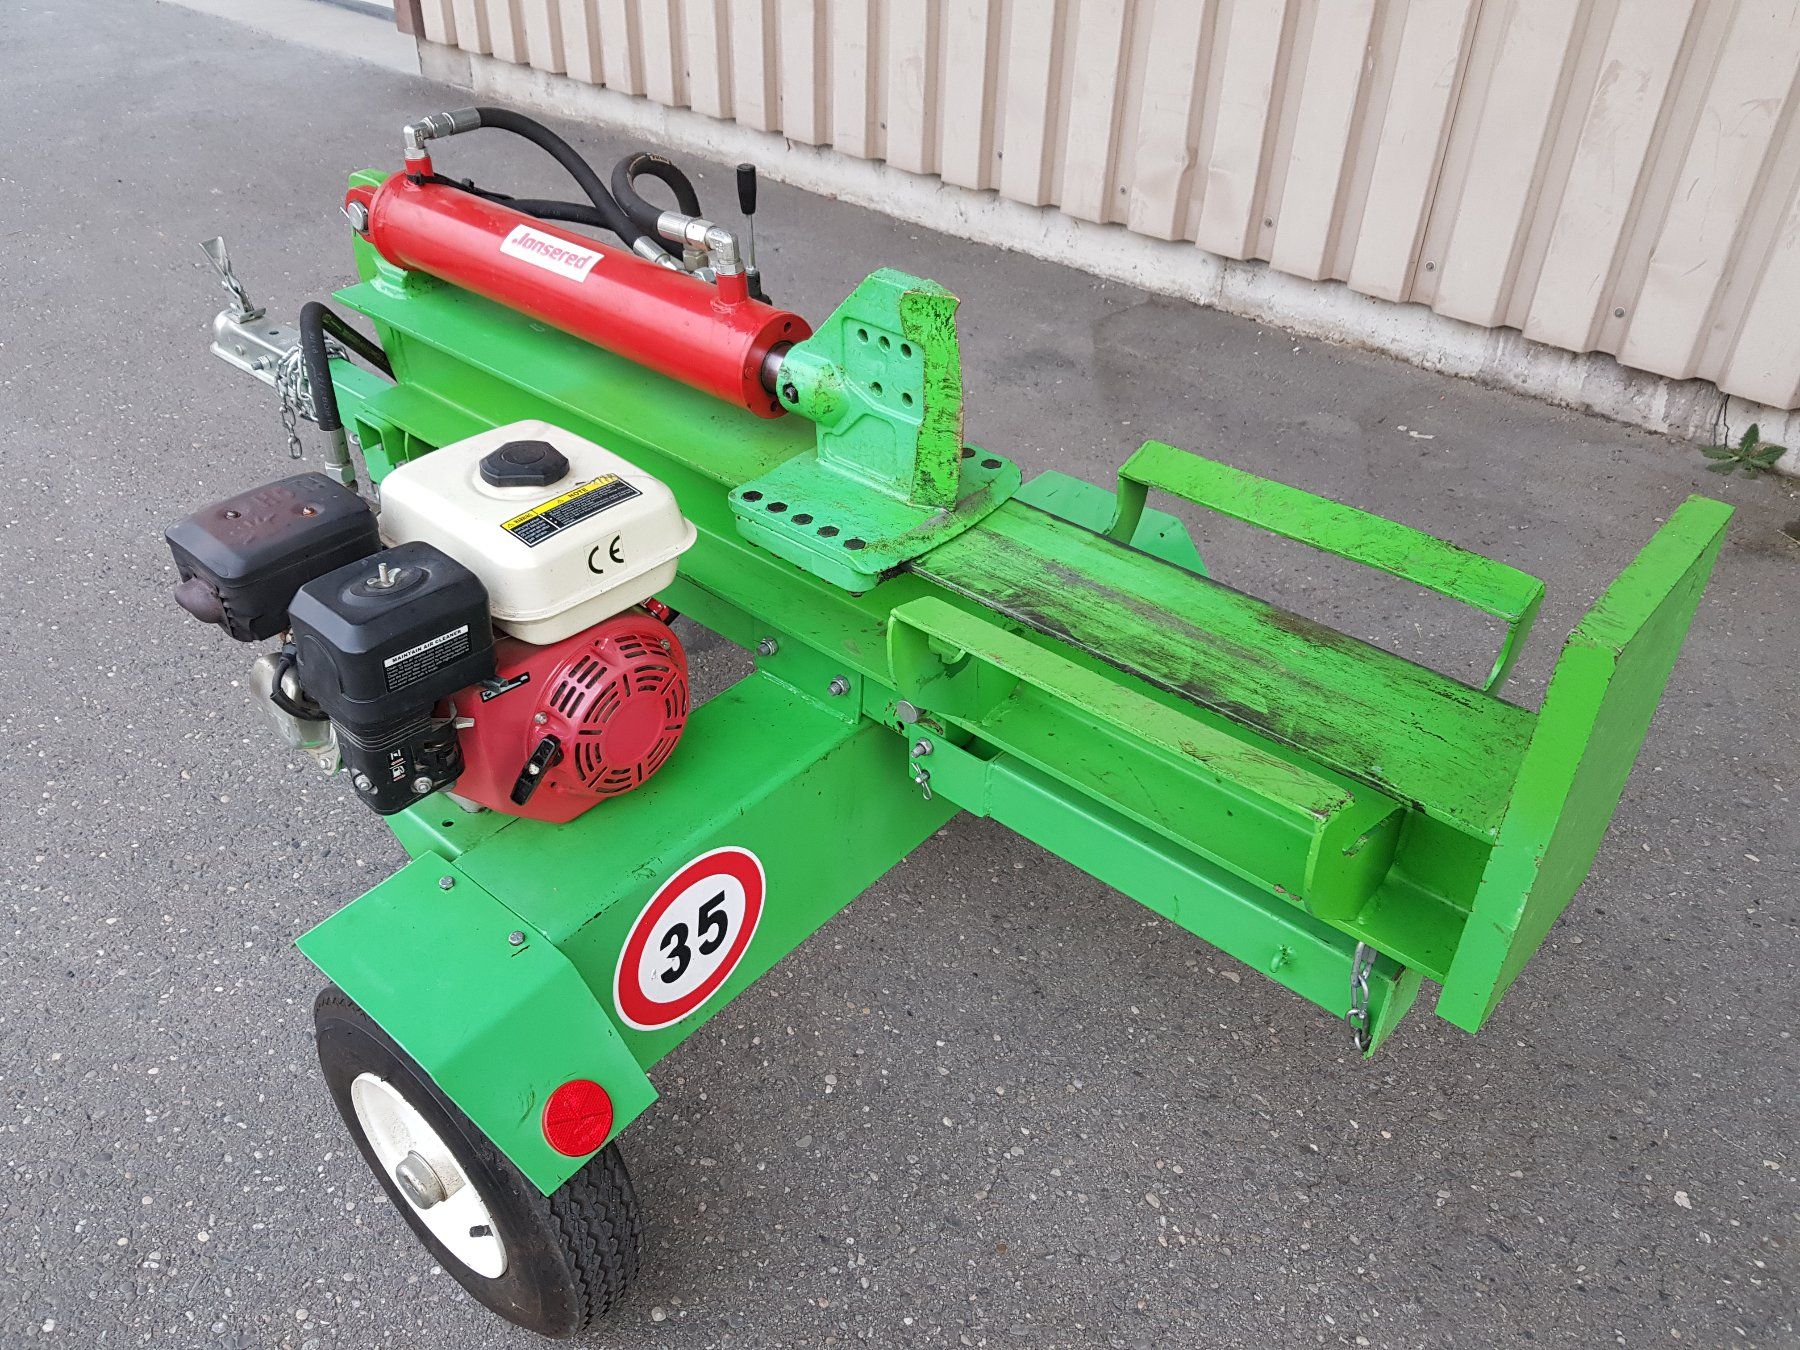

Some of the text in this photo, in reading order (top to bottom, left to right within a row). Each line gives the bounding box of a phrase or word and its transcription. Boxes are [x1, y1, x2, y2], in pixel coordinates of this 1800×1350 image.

[512, 233, 593, 270] Jonsered
[568, 487, 589, 499] NOTE
[588, 534, 625, 575] CE
[392, 629, 462, 663] MAINTAIN AIR CLEANER
[660, 890, 728, 984] 35
